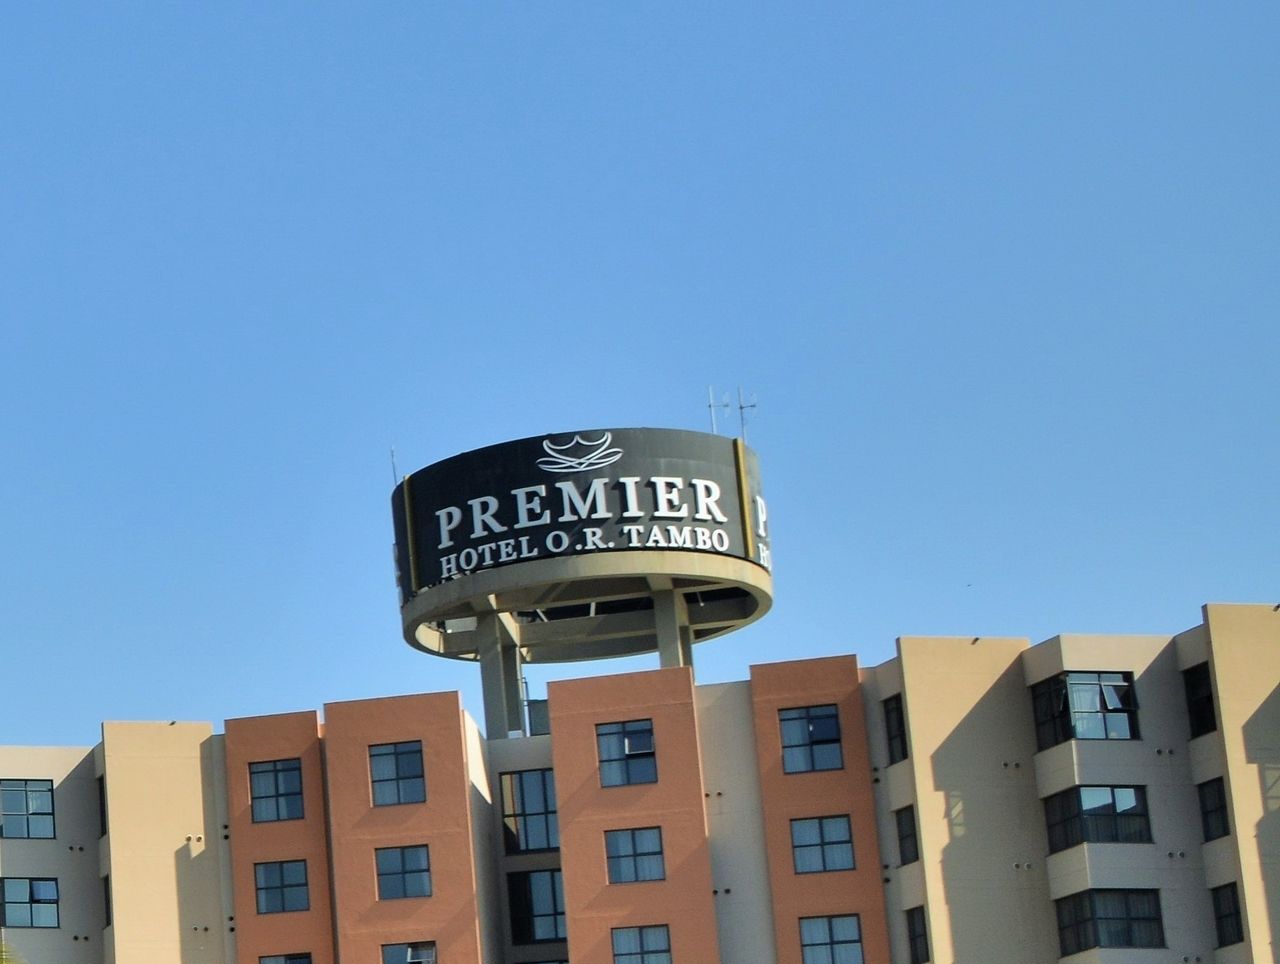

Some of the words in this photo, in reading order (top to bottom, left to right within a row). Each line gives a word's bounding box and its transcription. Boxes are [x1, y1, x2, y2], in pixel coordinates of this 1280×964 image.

[435, 476, 728, 549] PREMIER
[440, 535, 538, 579] HOTEL
[545, 526, 615, 553] O.R.
[623, 525, 730, 552] TAMBO
